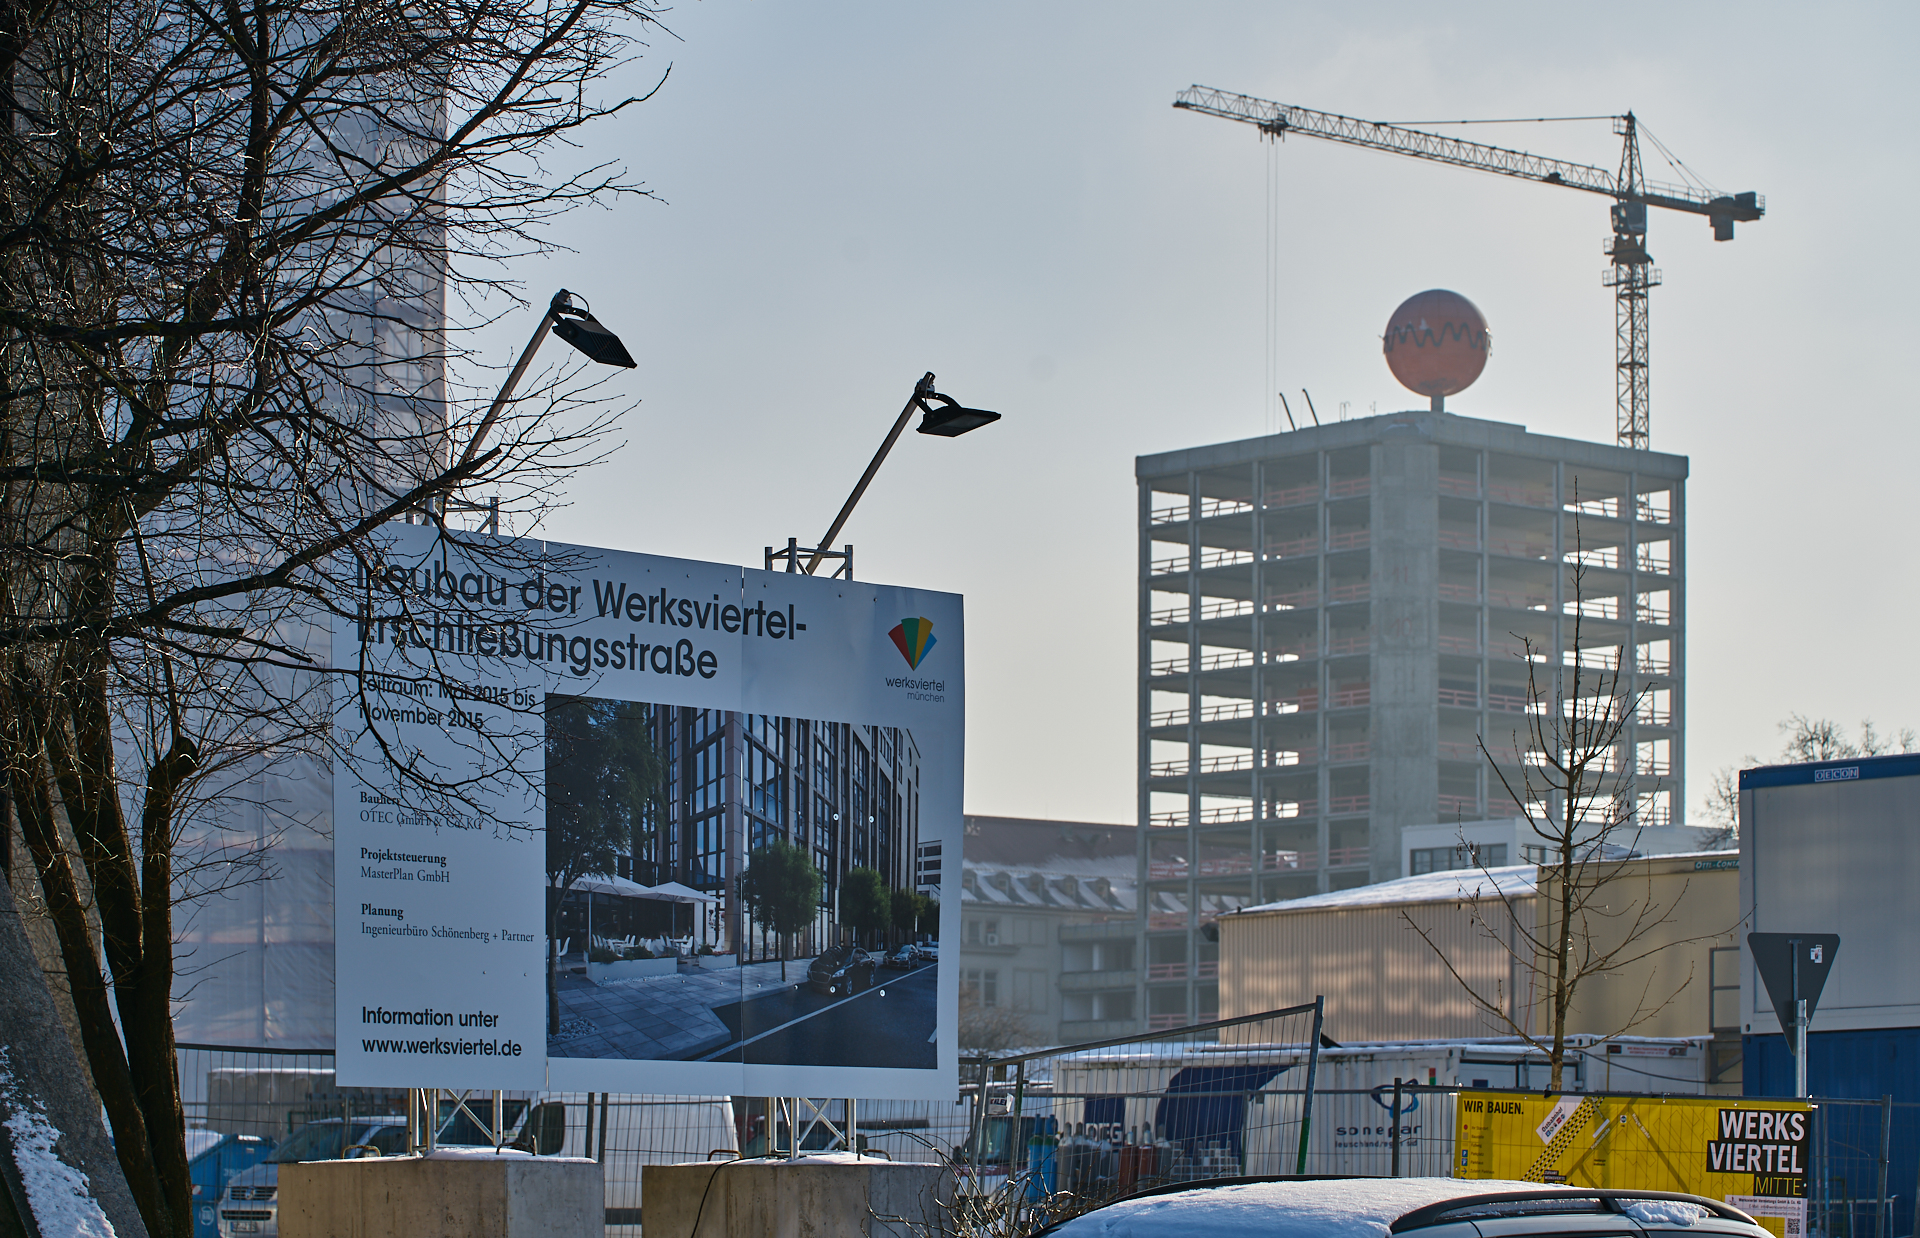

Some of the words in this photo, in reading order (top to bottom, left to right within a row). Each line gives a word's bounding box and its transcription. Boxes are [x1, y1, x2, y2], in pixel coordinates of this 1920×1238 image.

[521, 572, 581, 615] der
[593, 579, 807, 640] Werksviertel-
[357, 602, 718, 679] Erschließungsstraße
[885, 676, 945, 693] werksviertel
[474, 685, 508, 705] 2015
[513, 690, 536, 707] bis
[907, 691, 945, 703] münchen
[359, 702, 443, 726] November
[447, 711, 483, 730] 2015
[1815, 767, 1858, 781] OECON
[360, 810, 394, 824] OTEC
[360, 847, 447, 868] Projektsteuerung
[361, 865, 414, 882] MasterPlan
[417, 869, 450, 883] GmbH
[361, 903, 404, 921] Planung
[361, 922, 428, 938] Ingenieurbüro
[431, 925, 489, 944] Schönenberg
[501, 929, 535, 943] Partner
[362, 1006, 454, 1027] Information
[459, 1010, 499, 1028] unter
[362, 1037, 522, 1057] www.werksviertel.de
[1463, 1100, 1483, 1113] WIR
[1487, 1101, 1524, 1115] BAUEN.
[1541, 1106, 1563, 1133] Ostbahnhof
[1720, 1110, 1805, 1142] WERKS
[1709, 1142, 1803, 1174] VIERTEL
[1755, 1176, 1803, 1196] MITTE
